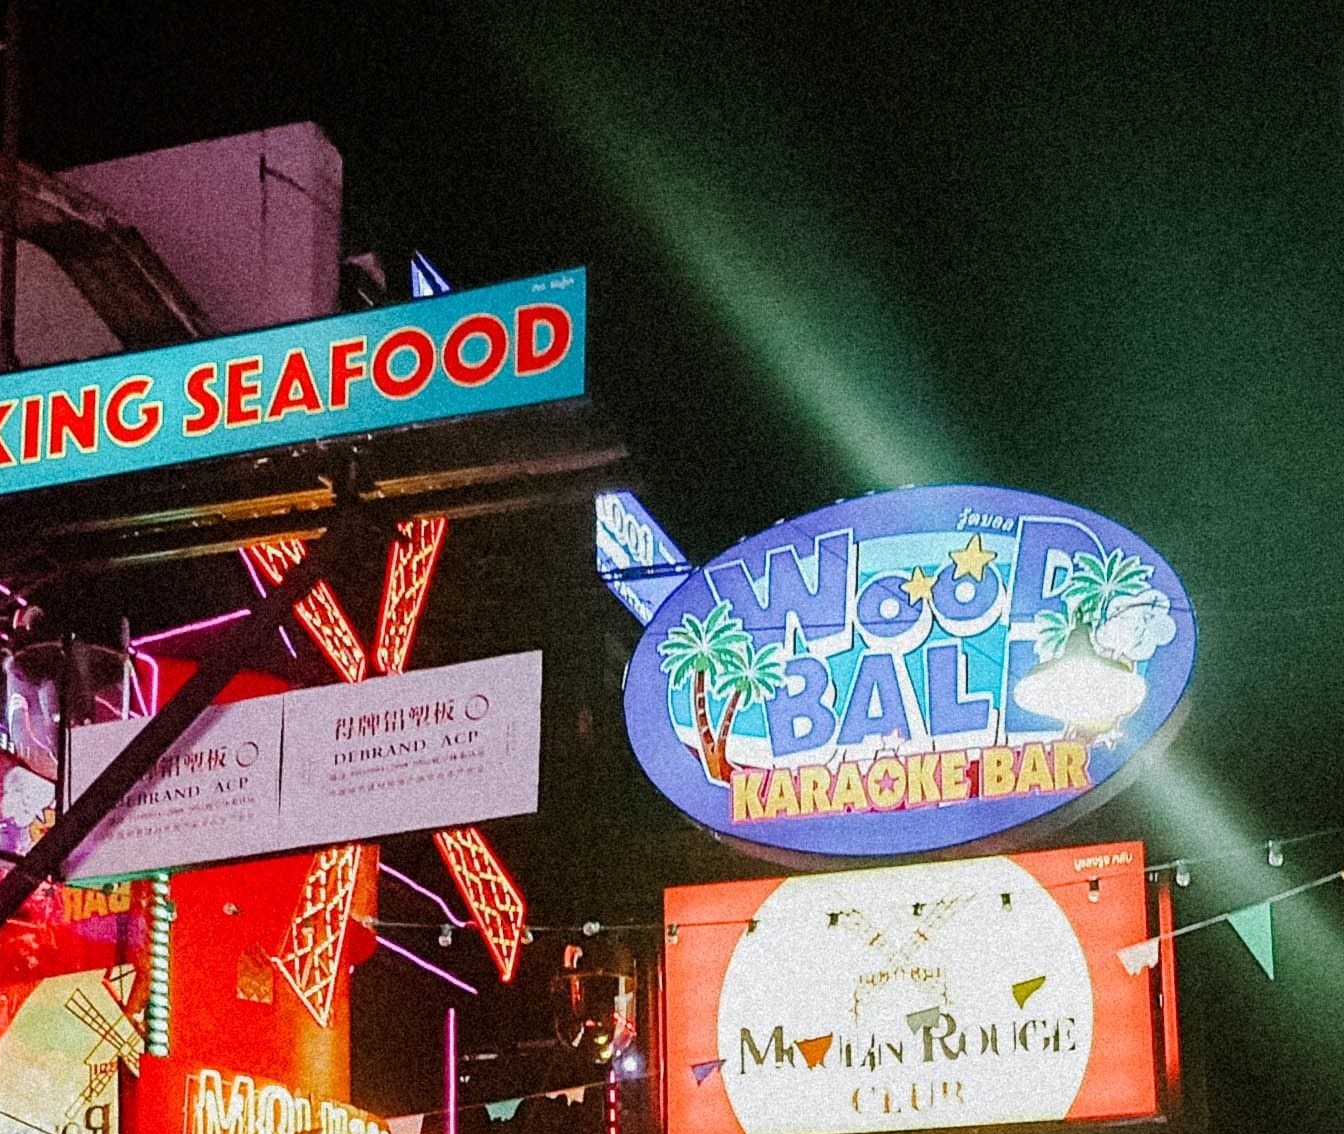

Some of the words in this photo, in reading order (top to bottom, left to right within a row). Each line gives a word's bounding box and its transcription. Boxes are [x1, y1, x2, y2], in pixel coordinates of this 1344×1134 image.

[183, 303, 573, 436] SEAFOOD
[333, 739, 427, 766] DEBRAND
[441, 731, 479, 750] ACP
[216, 777, 250, 793] ACP
[731, 750, 968, 822] KARAOKE
[978, 741, 1092, 797] BAR
[922, 1012, 1079, 1064] ROUGE
[852, 1079, 965, 1115] CLUB
